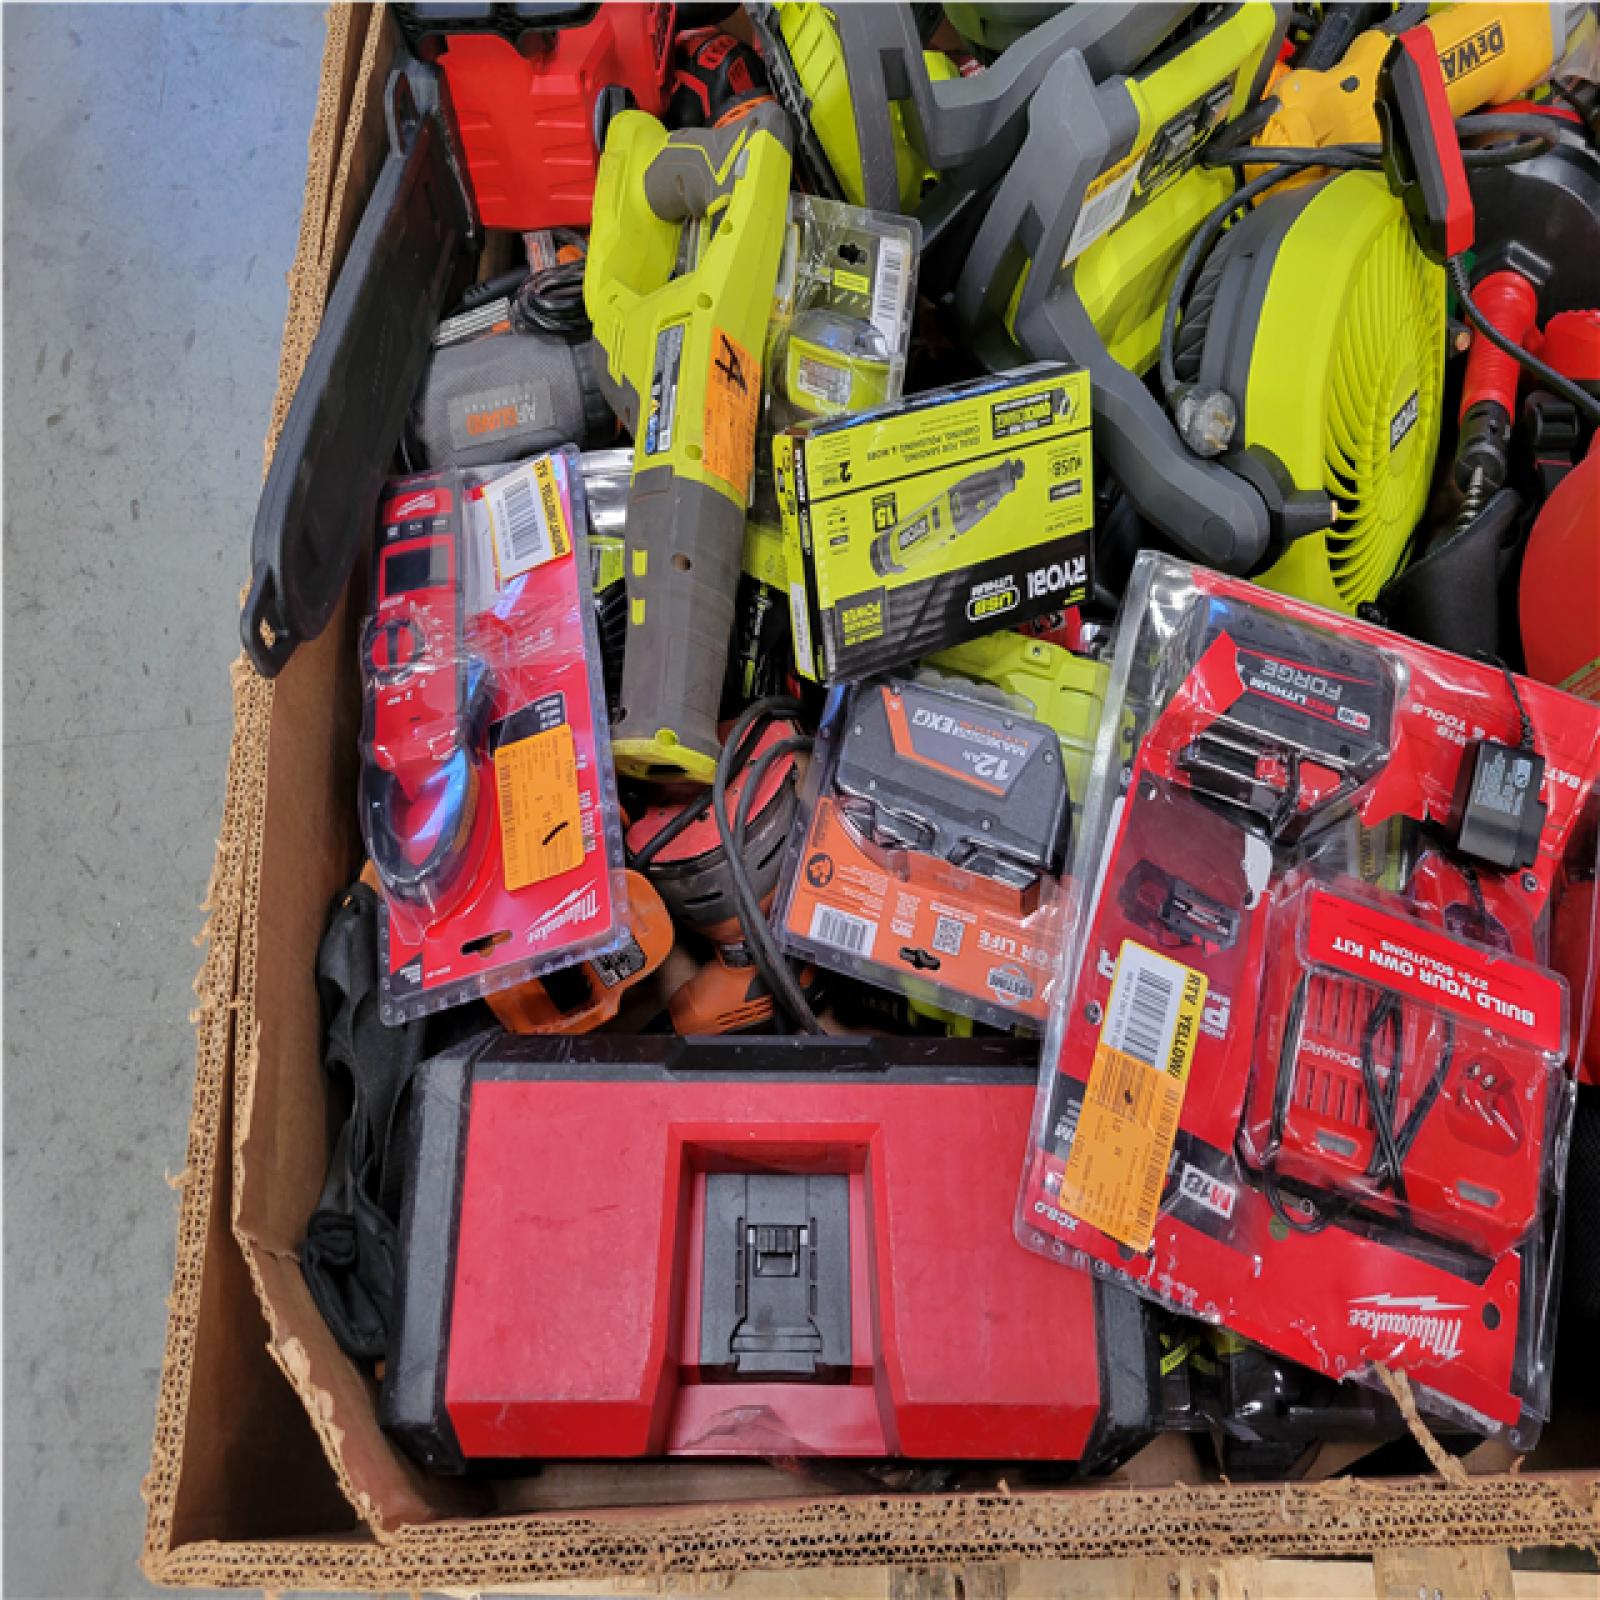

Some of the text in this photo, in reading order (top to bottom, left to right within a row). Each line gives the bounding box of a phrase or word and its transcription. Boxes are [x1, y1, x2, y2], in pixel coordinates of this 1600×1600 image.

[1442, 26, 1505, 84] DEWA
[1026, 555, 1088, 599] RYOBI
[1260, 660, 1343, 701] FORGE
[528, 889, 602, 946] Milwaukee
[1332, 935, 1536, 1027] BUILD YOUR OWN KIT
[1184, 1171, 1234, 1215] M18
[1348, 1308, 1465, 1361] Milwaukee
